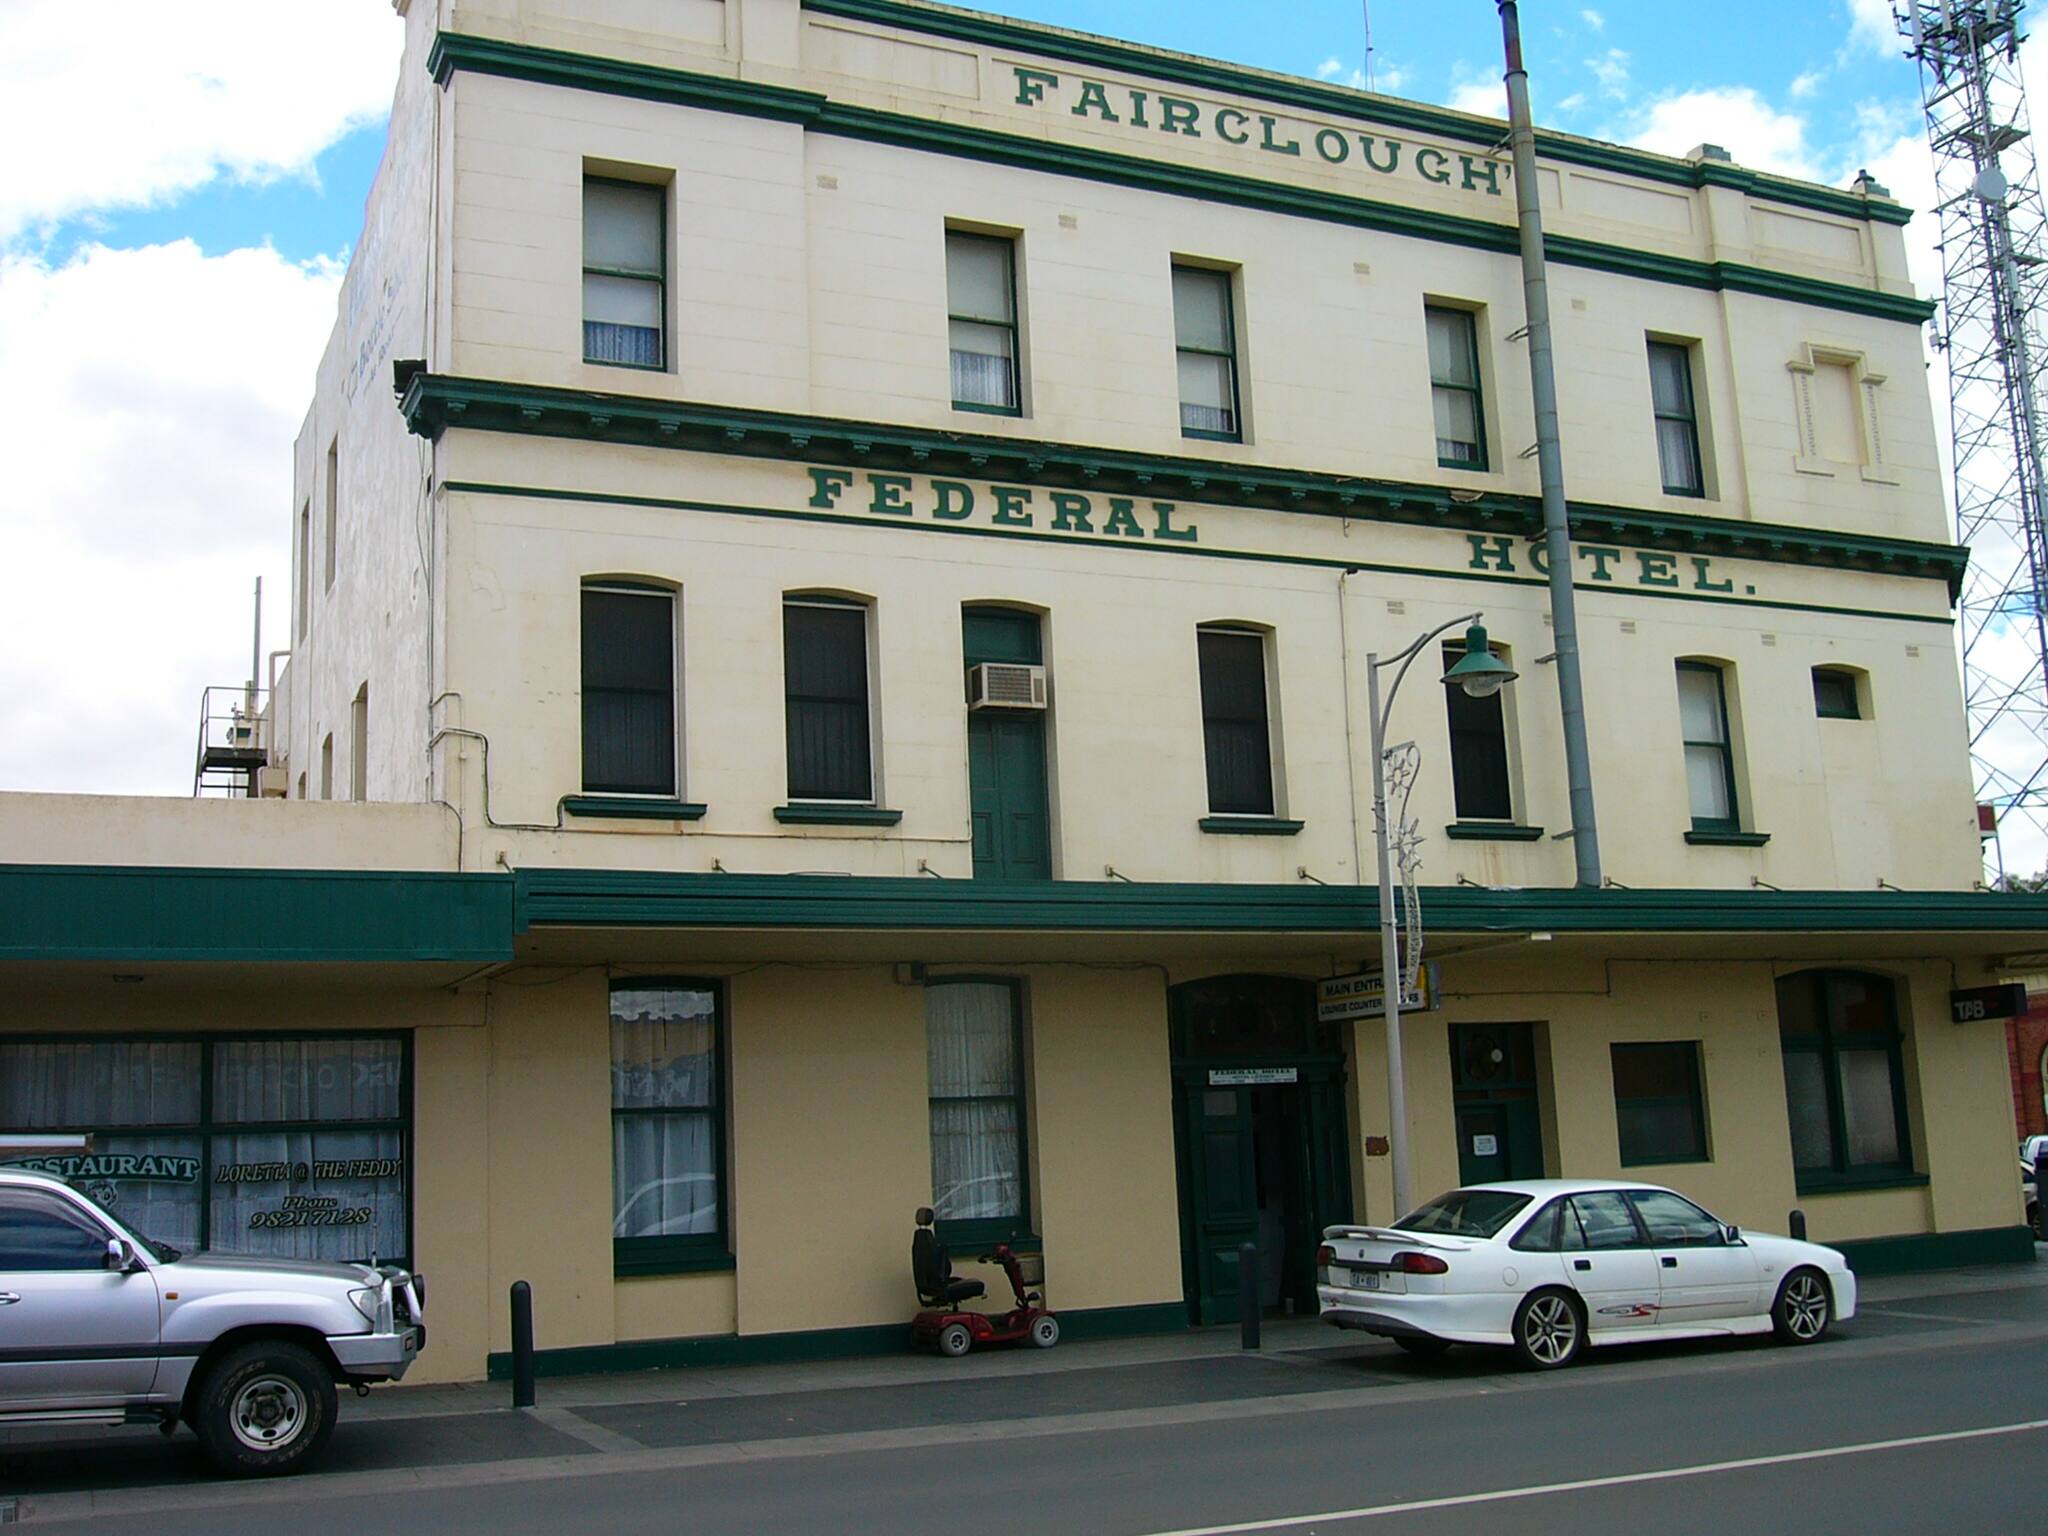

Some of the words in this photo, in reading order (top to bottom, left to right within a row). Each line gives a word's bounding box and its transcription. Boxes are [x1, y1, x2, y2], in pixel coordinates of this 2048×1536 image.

[807, 466, 1198, 542] FEDERAL
[1325, 982, 1350, 996] MAIN
[1348, 998, 1383, 1010] COUNTER
[1954, 1000, 1985, 1020] TAB
[8, 1155, 199, 1178] ESTAURANT
[216, 1162, 292, 1183] LORETTA
[313, 1160, 345, 1180] THE
[348, 1159, 402, 1177] FEDDY
[282, 1196, 338, 1209] Phone
[251, 1207, 371, 1228] 98217128
